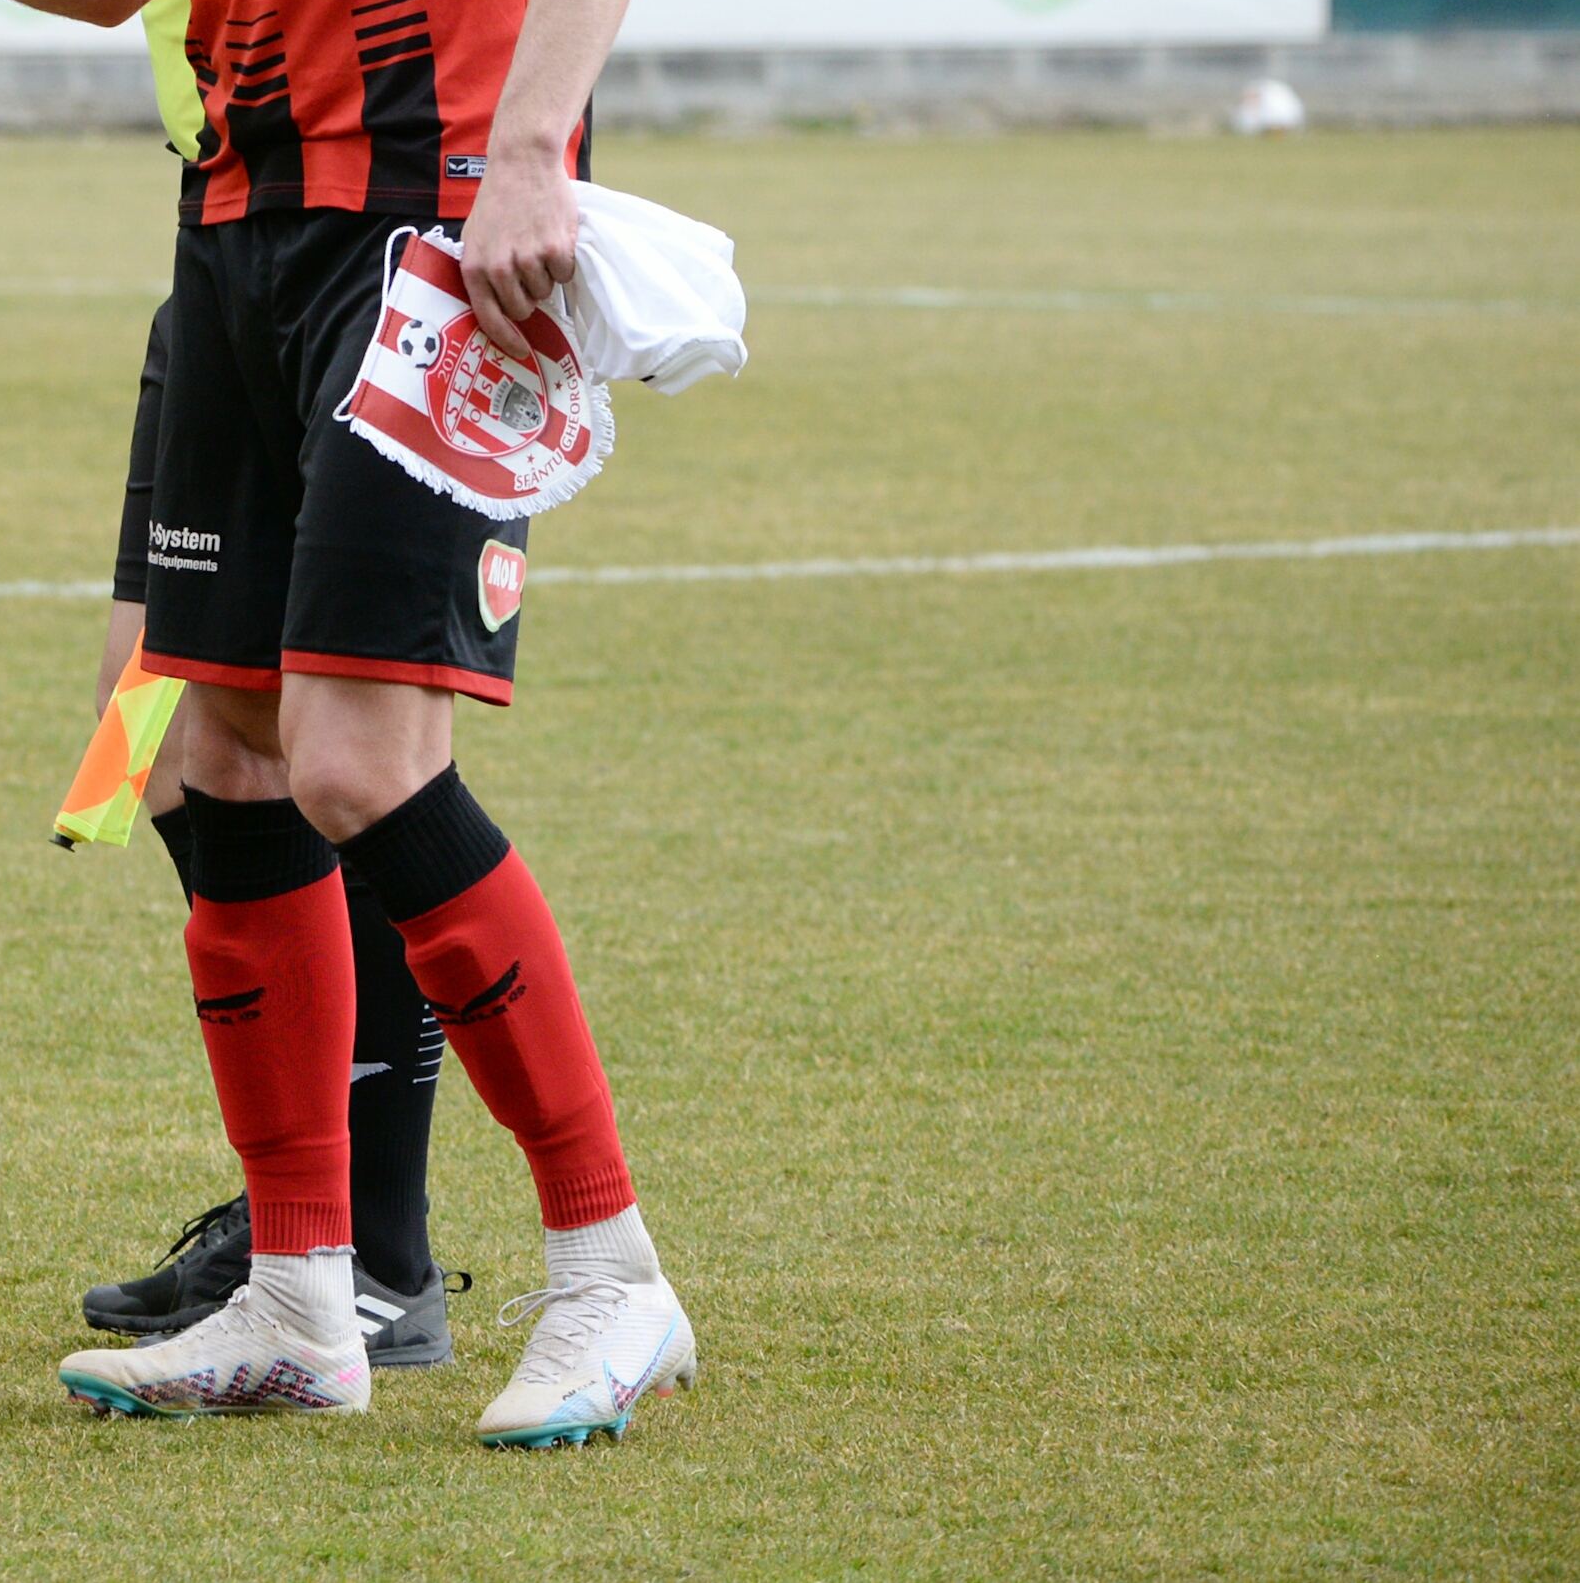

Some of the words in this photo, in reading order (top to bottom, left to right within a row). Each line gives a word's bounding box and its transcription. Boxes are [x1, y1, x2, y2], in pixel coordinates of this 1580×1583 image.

[437, 339, 463, 383] 2011
[446, 340, 484, 421] SEPS
[559, 355, 582, 451] GHEORGHE
[159, 552, 218, 572] Equipments
[487, 554, 519, 592] MOL
